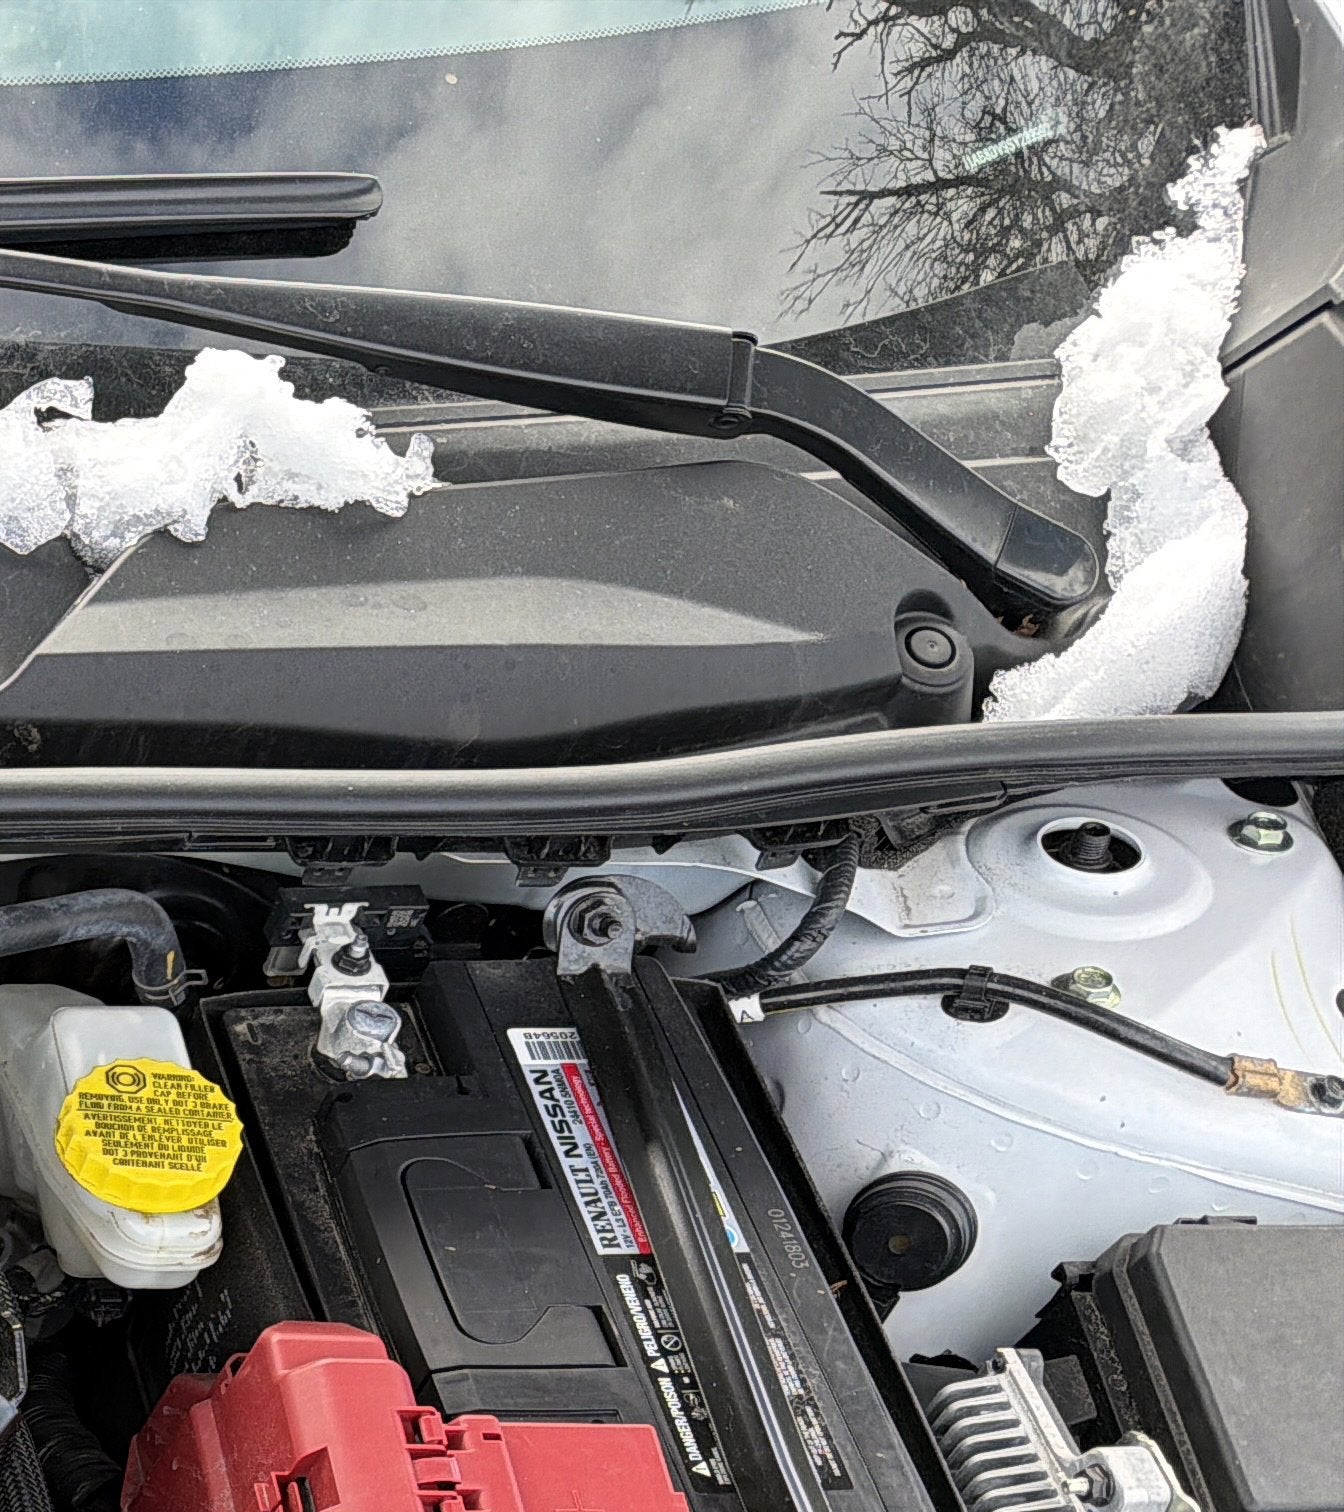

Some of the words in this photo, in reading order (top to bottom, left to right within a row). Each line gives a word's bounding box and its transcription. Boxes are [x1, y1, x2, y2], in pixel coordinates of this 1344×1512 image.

[128, 1096, 145, 1104] USE
[176, 1091, 209, 1100] BEFORE
[145, 1106, 181, 1116] SEALED
[529, 1069, 583, 1158] NISSAN
[151, 1126, 214, 1138] REMPLISSAGE
[212, 1122, 224, 1131] LE
[101, 1139, 155, 1150] SEULEMENT
[569, 1164, 622, 1250] RENAULT
[767, 1207, 810, 1270] 01241803
[658, 1378, 703, 1461] DANGER/POISON
